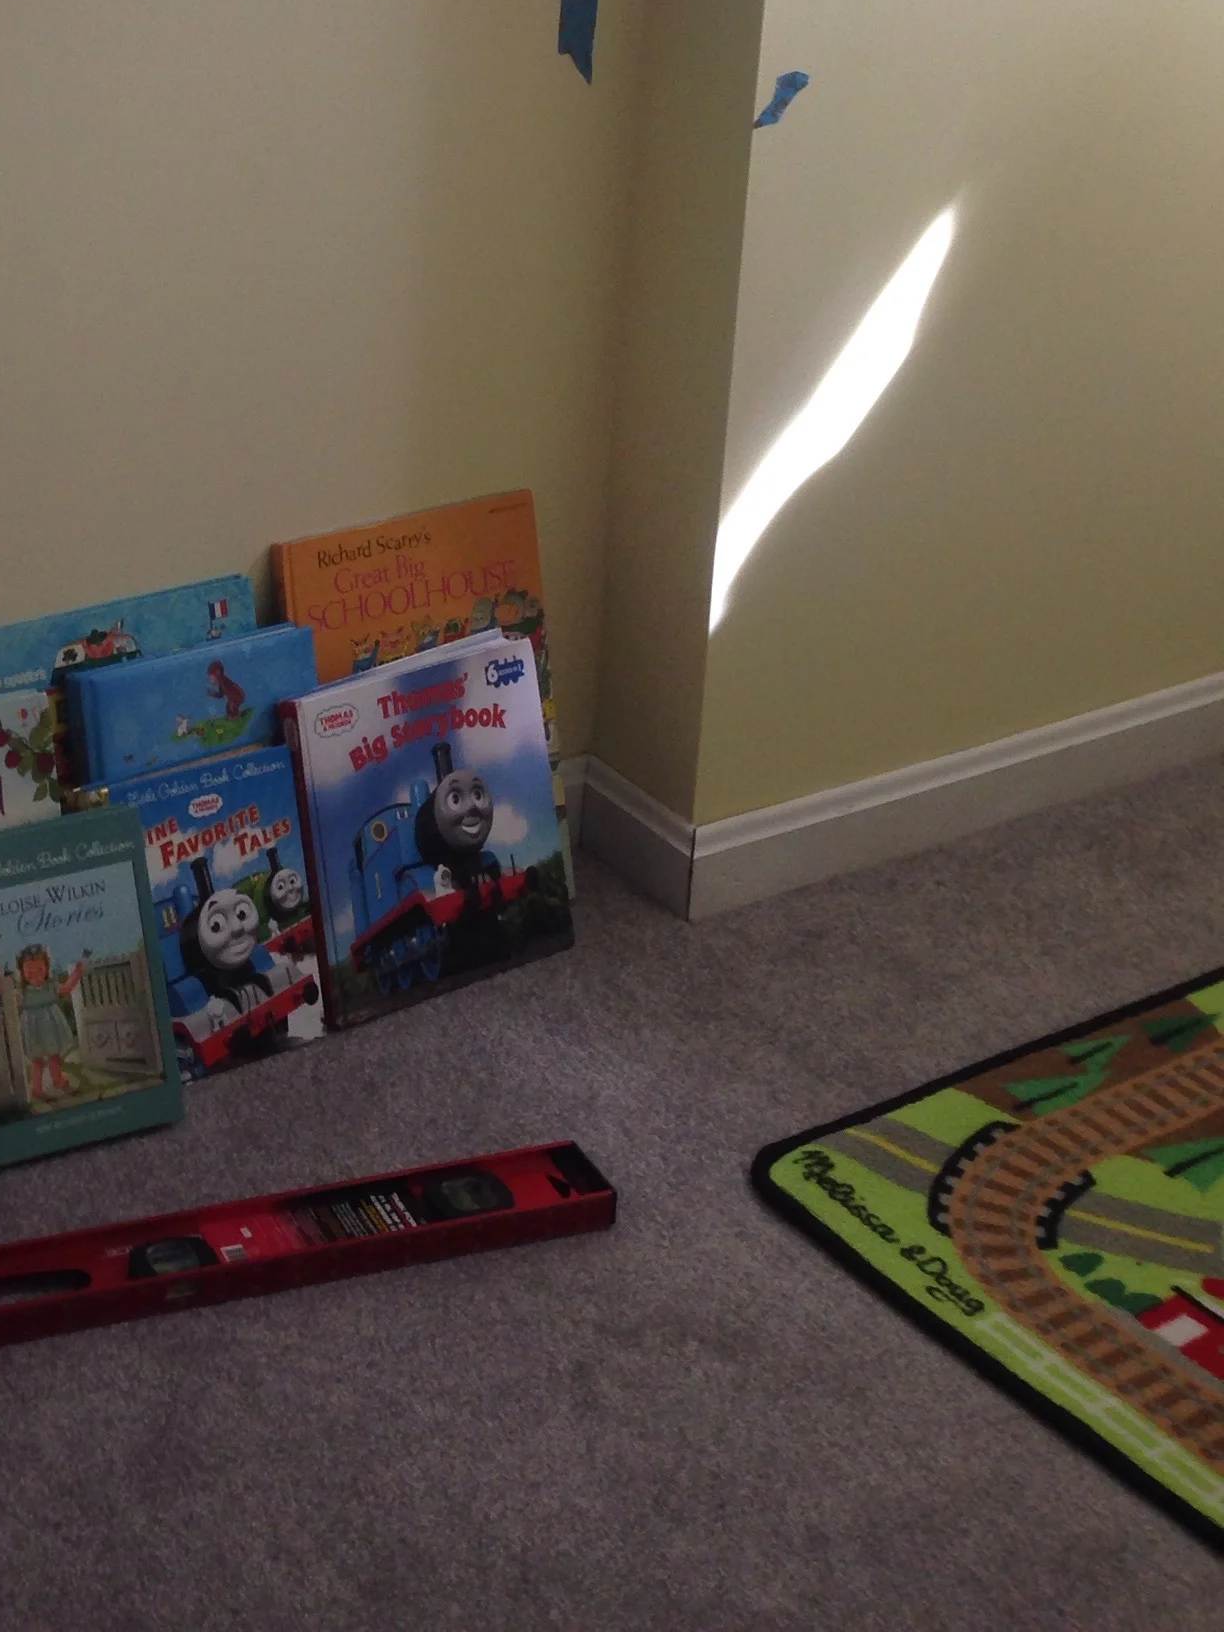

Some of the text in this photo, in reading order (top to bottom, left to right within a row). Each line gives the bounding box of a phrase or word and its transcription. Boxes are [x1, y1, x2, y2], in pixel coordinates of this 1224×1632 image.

[316, 529, 433, 570] Richard Scarry's
[307, 559, 519, 632] SCHOOLHOUSE
[333, 554, 426, 596] Great Big
[319, 709, 353, 726] THOMAS
[377, 672, 469, 720] Thomas'
[348, 703, 507, 772] Big Storybook
[159, 804, 262, 869] FAVORITE
[233, 816, 292, 858] TALES
[45, 878, 107, 906] WILKIN
[792, 1149, 986, 1317] Melissa & Doug
